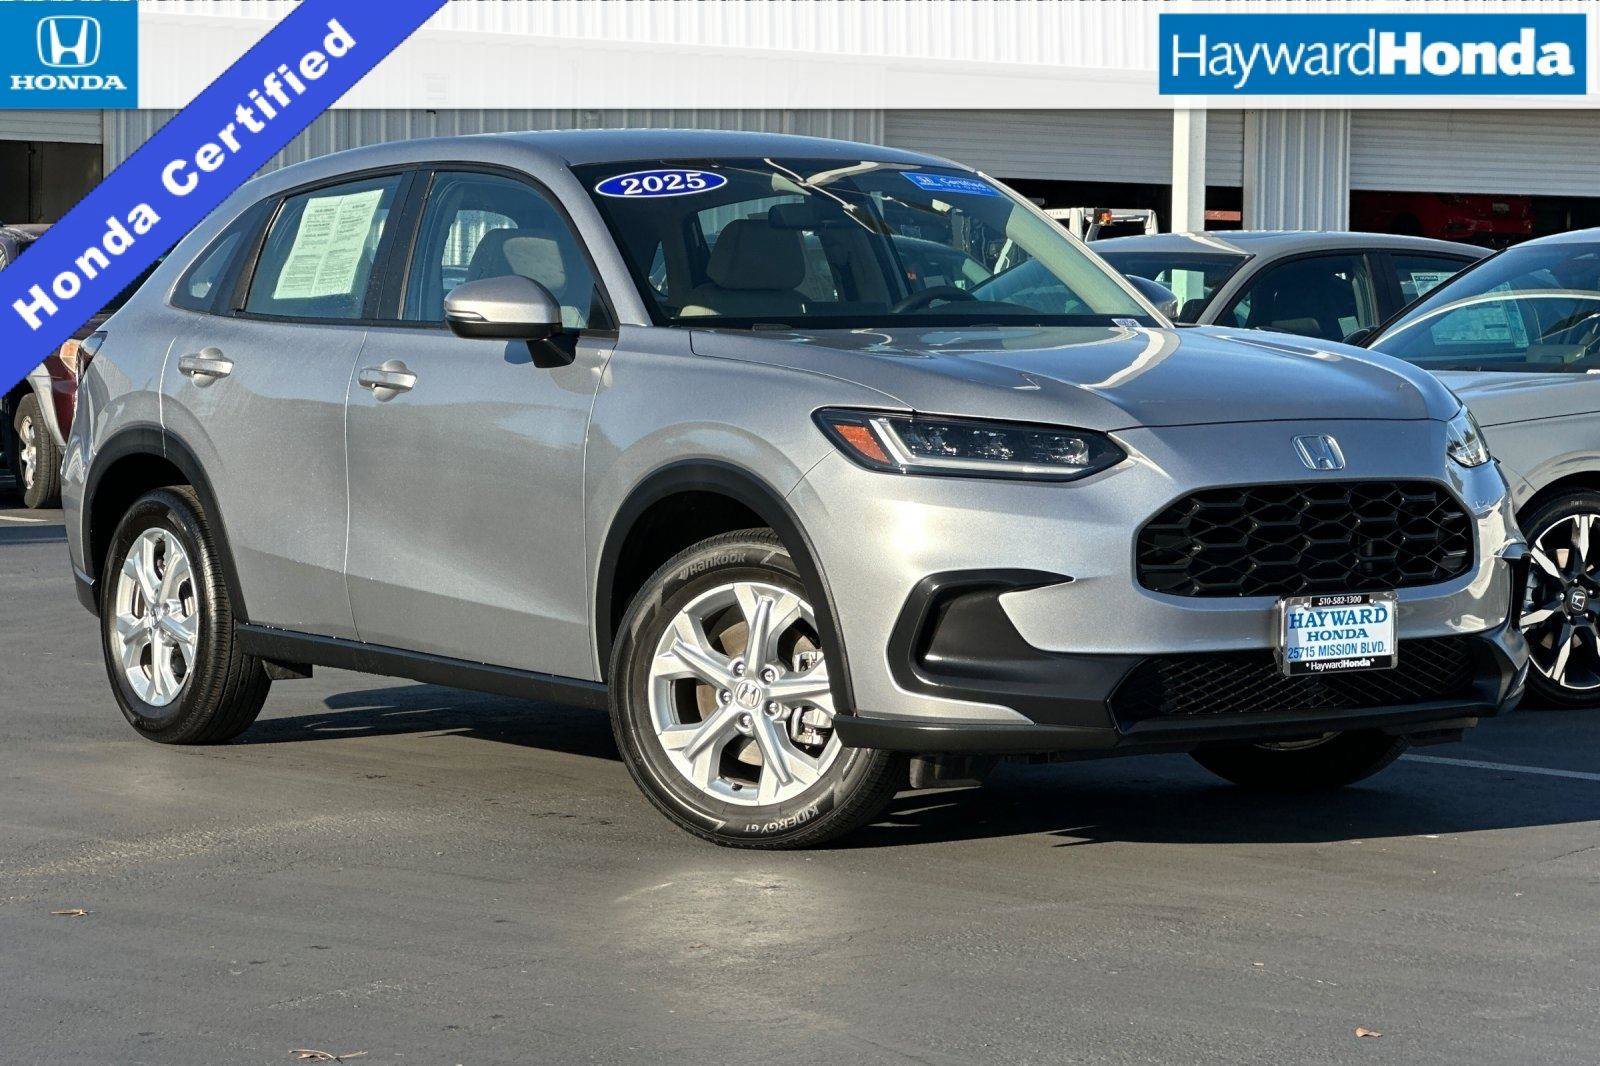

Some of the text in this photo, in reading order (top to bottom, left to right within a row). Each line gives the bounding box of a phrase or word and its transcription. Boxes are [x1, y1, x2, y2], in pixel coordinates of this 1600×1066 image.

[620, 173, 707, 195] 2025
[1318, 596, 1362, 605] 510-582-1300
[1289, 607, 1388, 629] HAYWARD
[1307, 628, 1369, 642] HONDA
[1288, 641, 1387, 659] 25715 MISSION BLVD.
[761, 805, 819, 834] KINERGY
